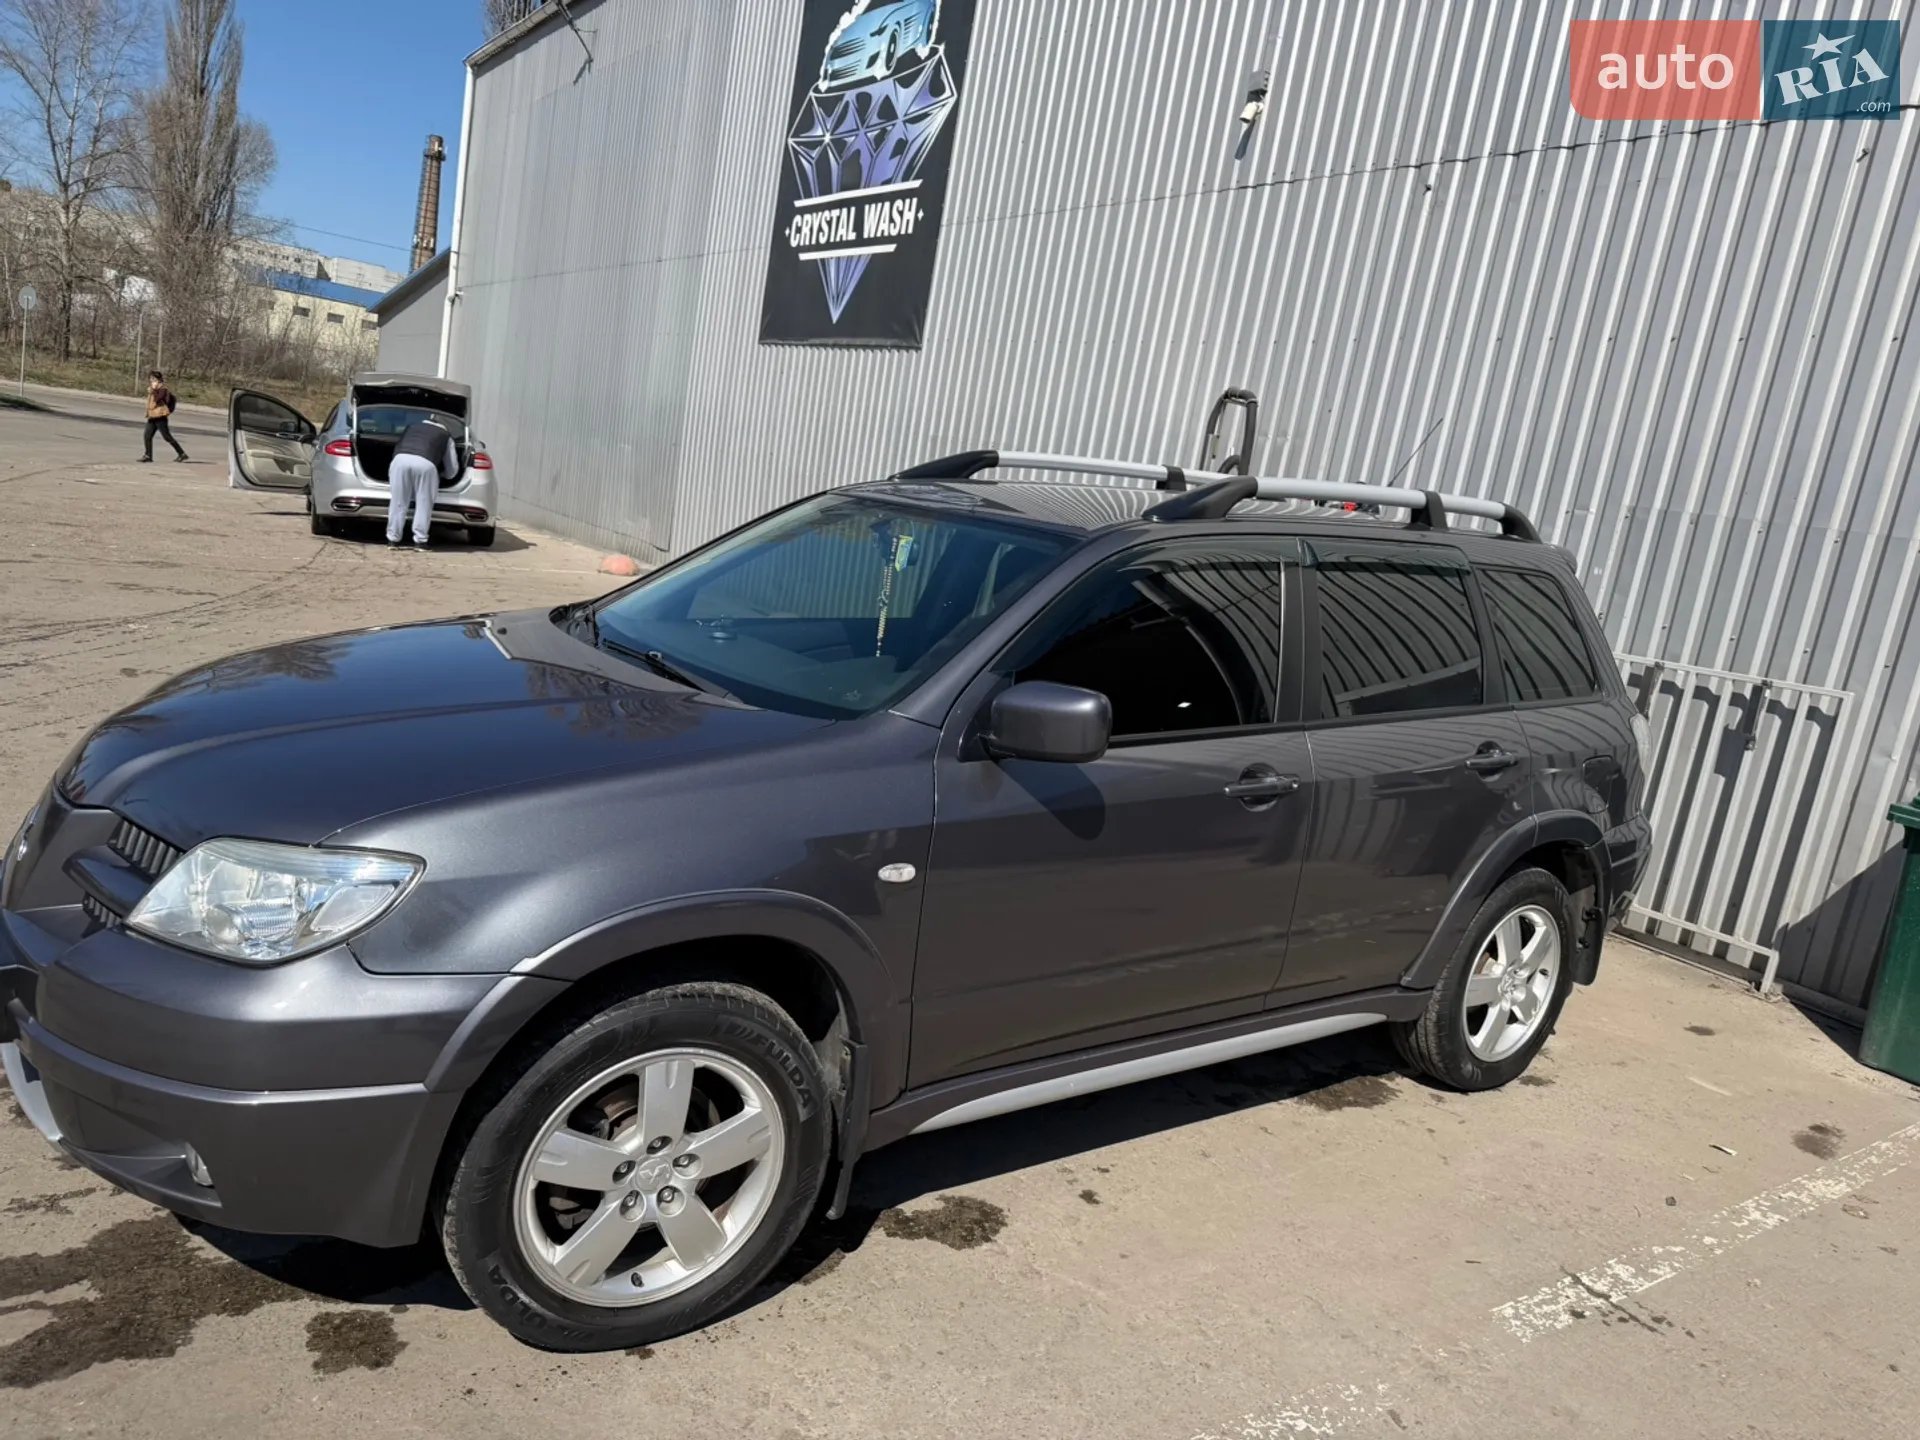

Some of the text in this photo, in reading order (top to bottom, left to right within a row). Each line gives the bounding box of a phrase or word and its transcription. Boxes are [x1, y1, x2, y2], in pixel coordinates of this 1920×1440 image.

[790, 197, 918, 247] CRYSTAL WASH
[749, 1033, 812, 1108] FULDA
